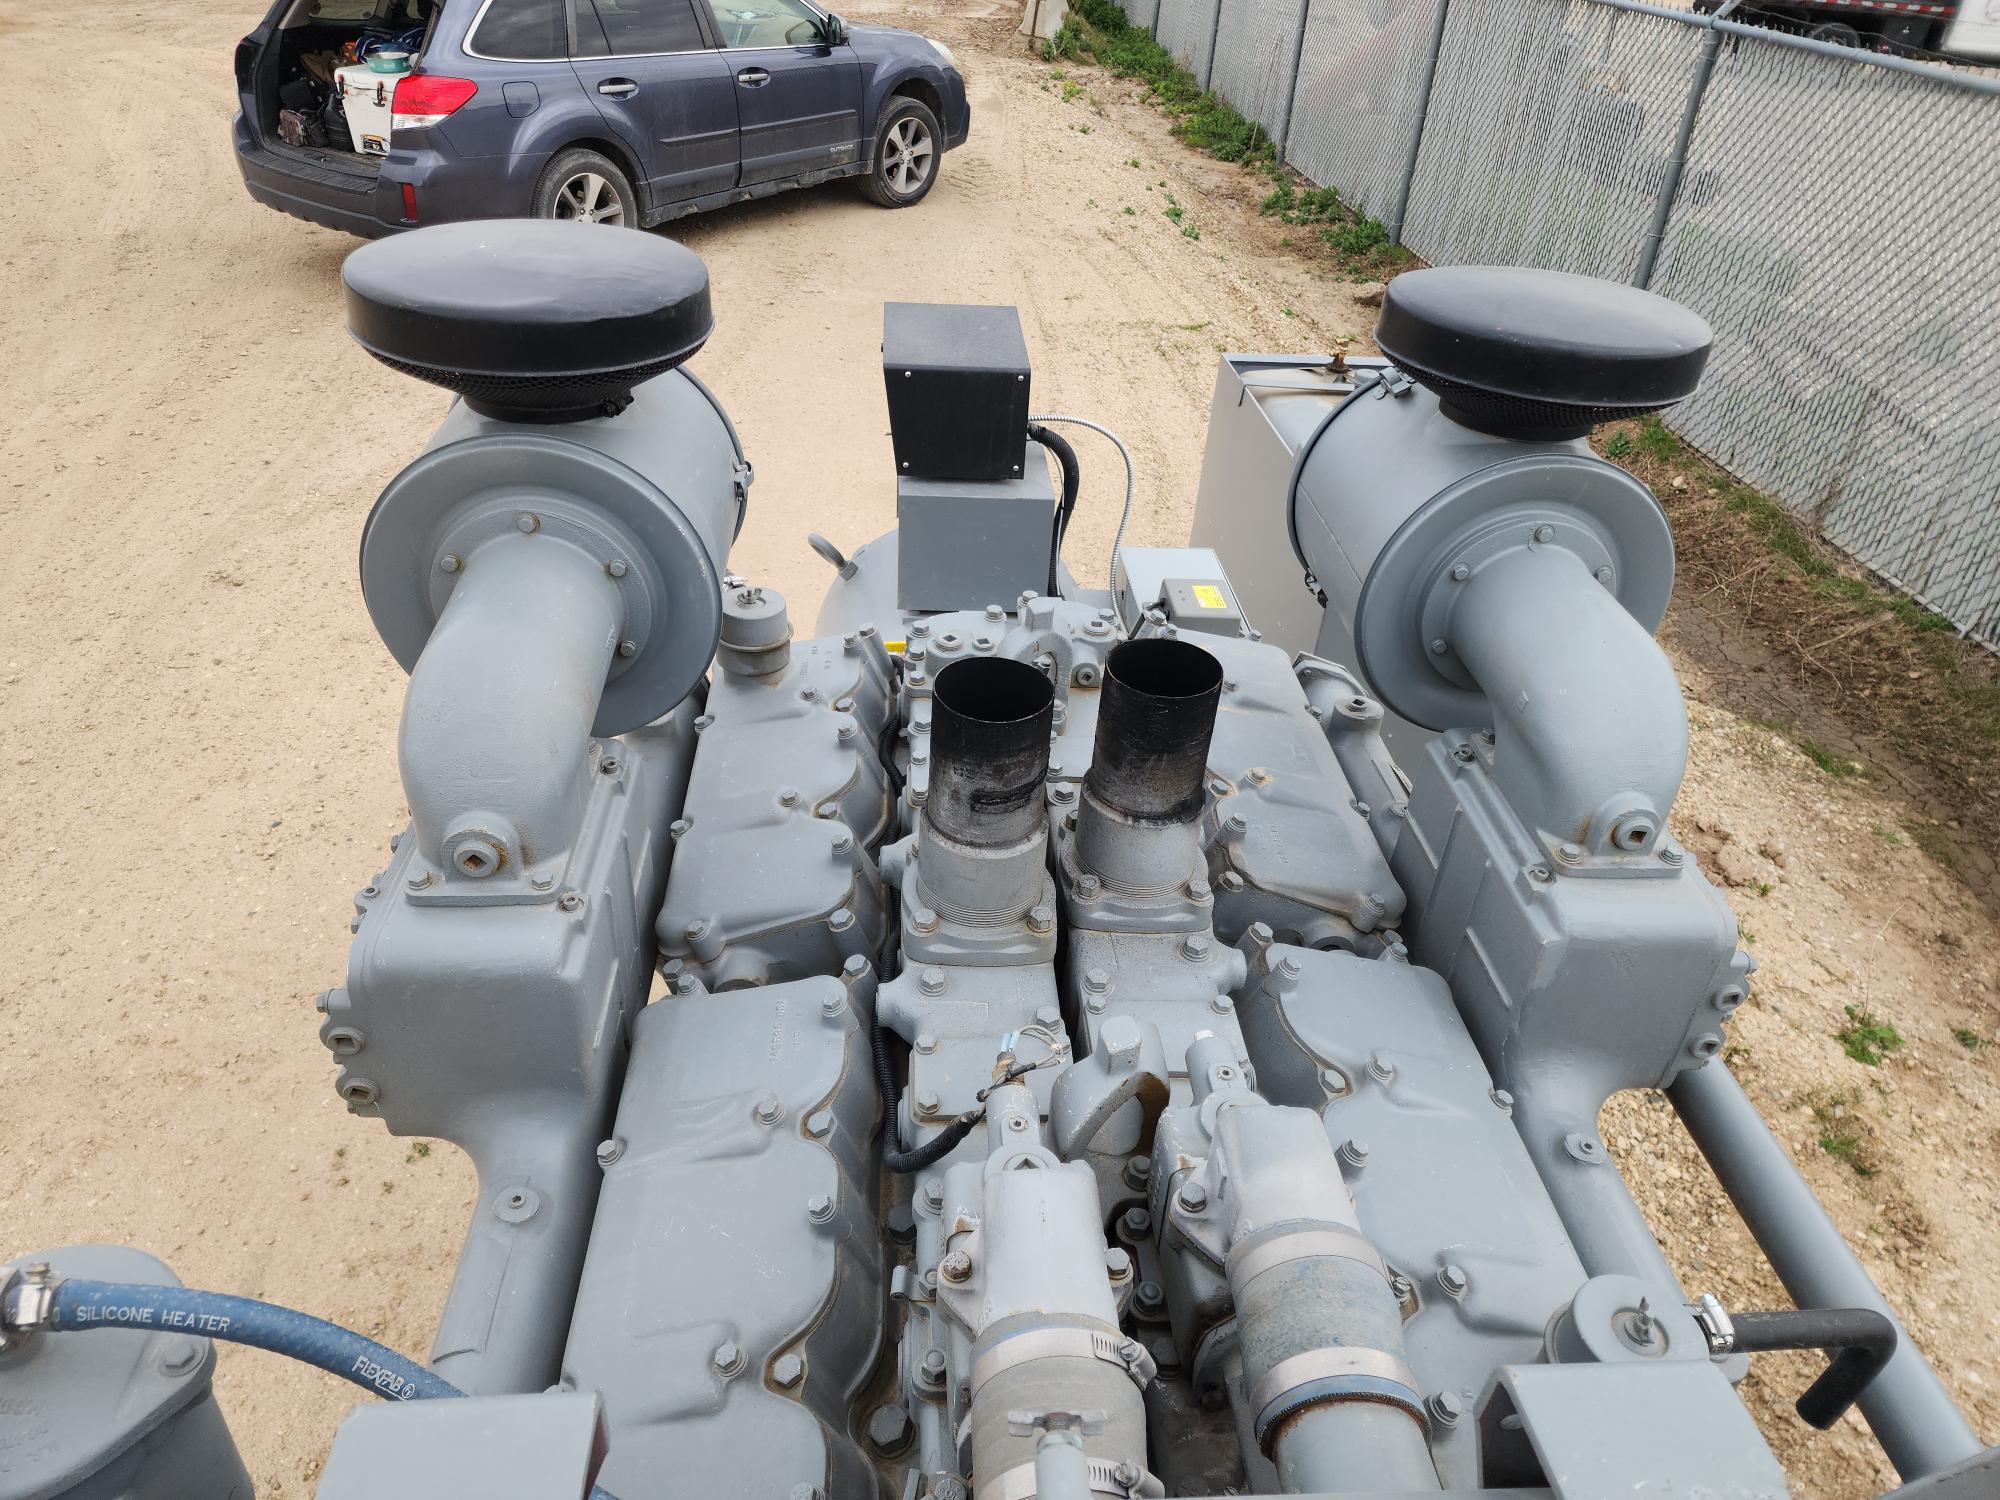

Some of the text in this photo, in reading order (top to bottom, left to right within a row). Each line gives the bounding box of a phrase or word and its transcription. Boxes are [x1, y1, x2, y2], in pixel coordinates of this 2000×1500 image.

[77, 1305, 154, 1323] SILICONE
[161, 1309, 231, 1332] HEATER
[351, 1355, 404, 1392] FLEXFAB
